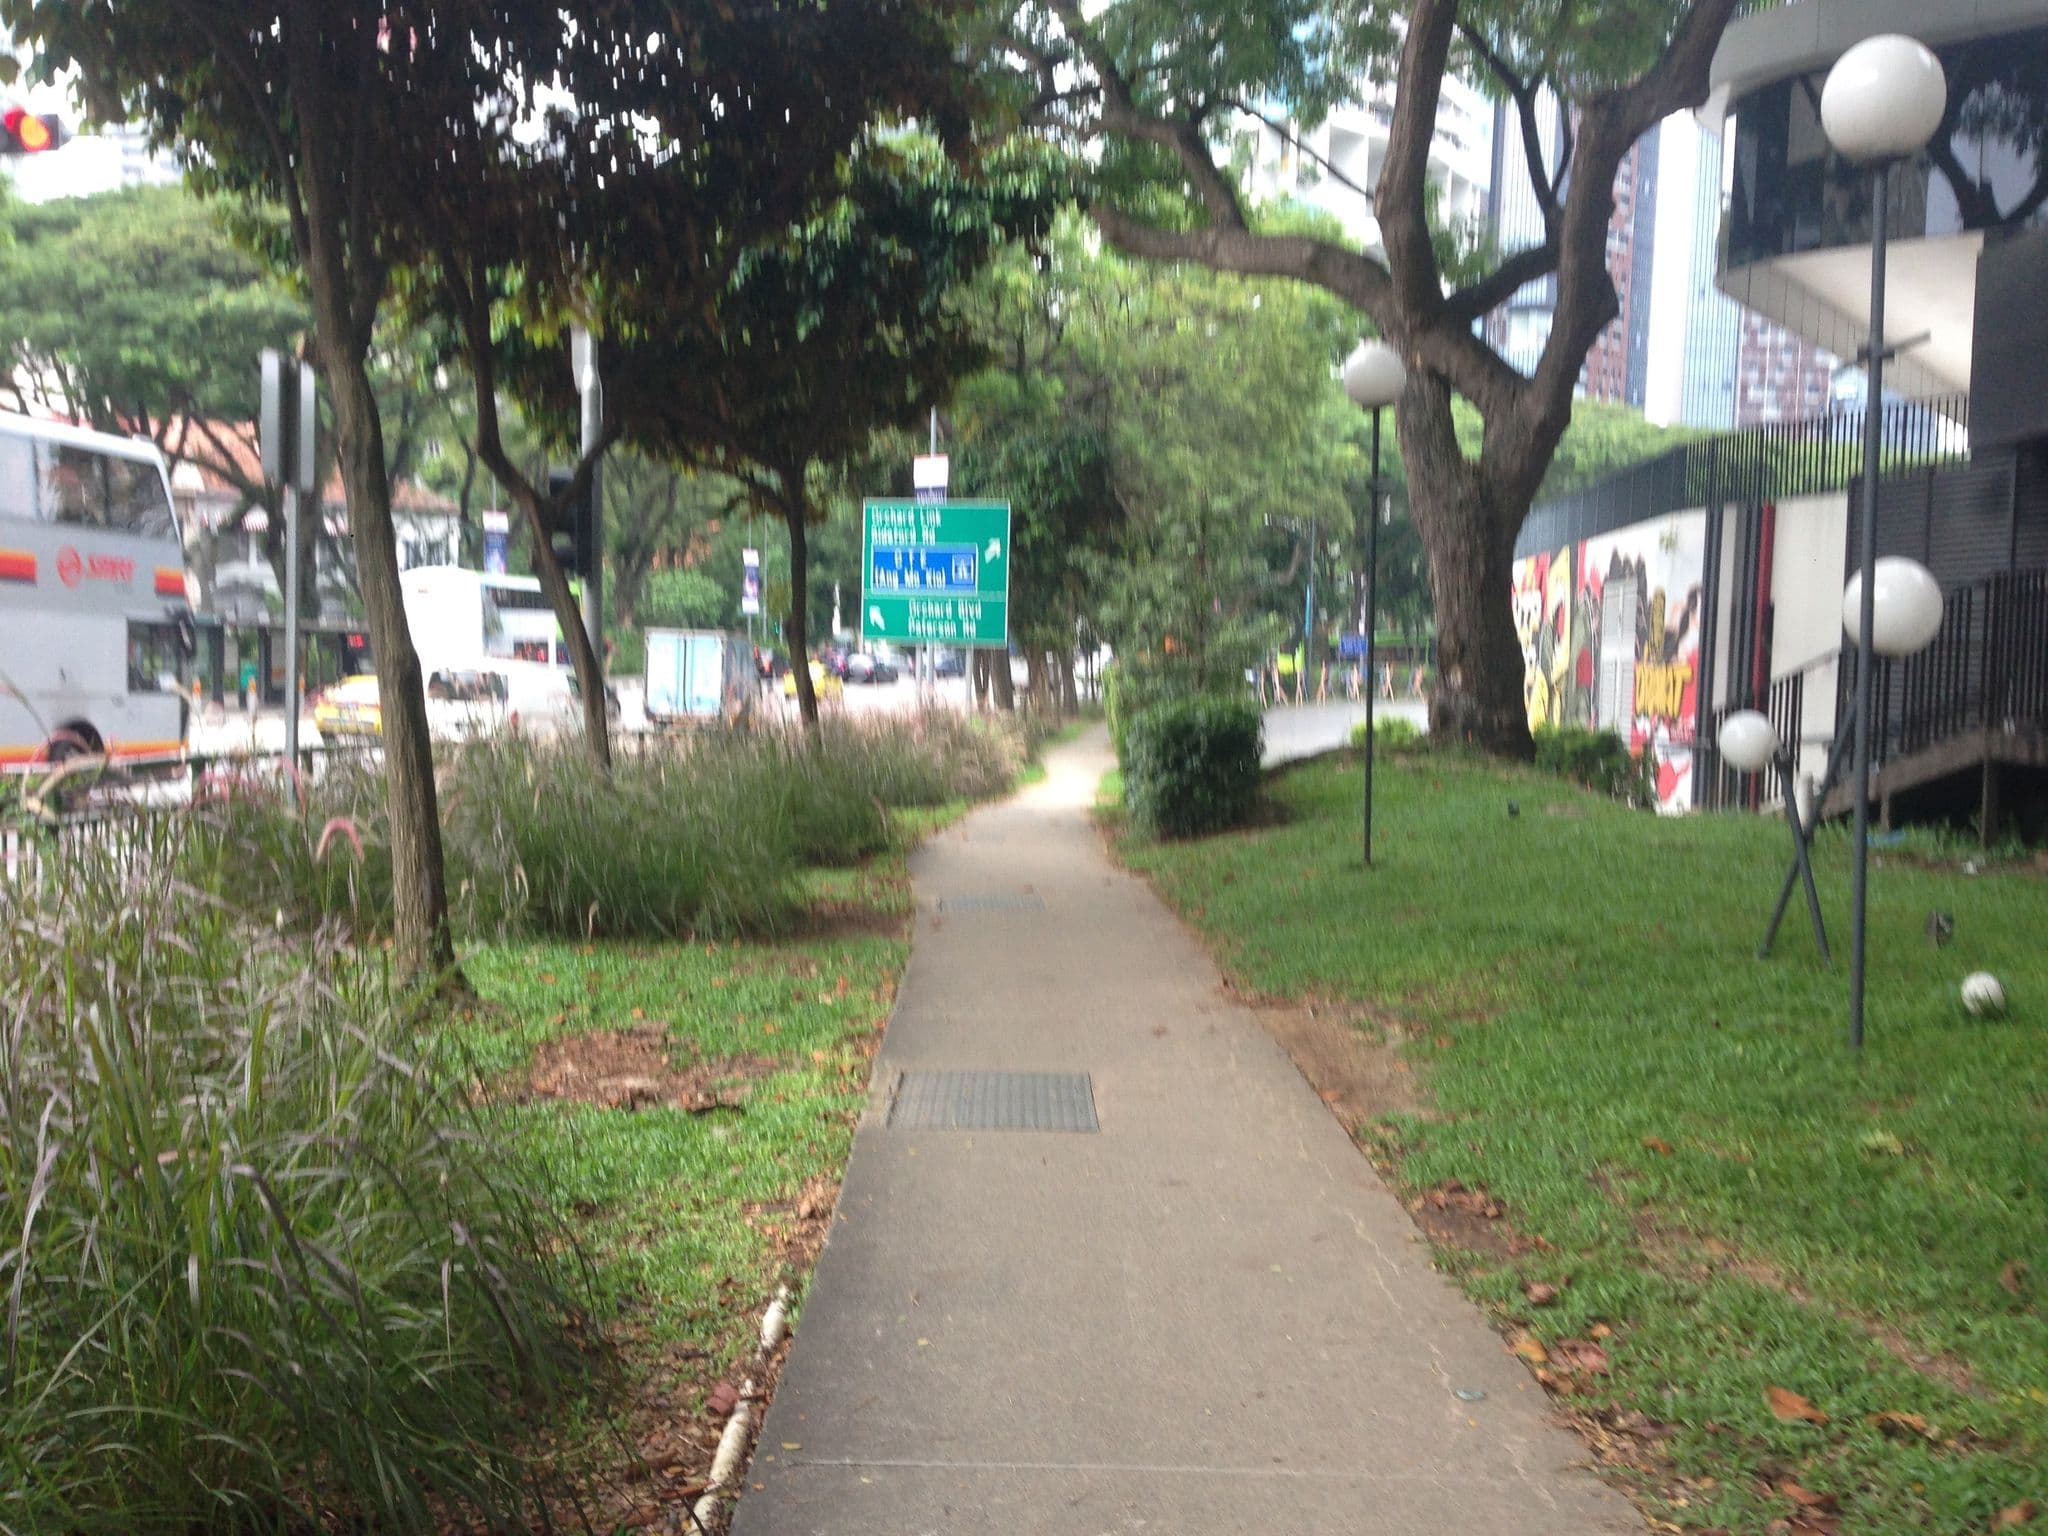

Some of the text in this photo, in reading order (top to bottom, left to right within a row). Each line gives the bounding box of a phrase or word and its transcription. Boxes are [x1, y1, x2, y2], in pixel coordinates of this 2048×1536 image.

[872, 506, 941, 528] Orchard Link
[872, 525, 917, 546] Bideford
[908, 599, 982, 620] Orchard Blvd
[908, 616, 977, 640] Paterson Rd
